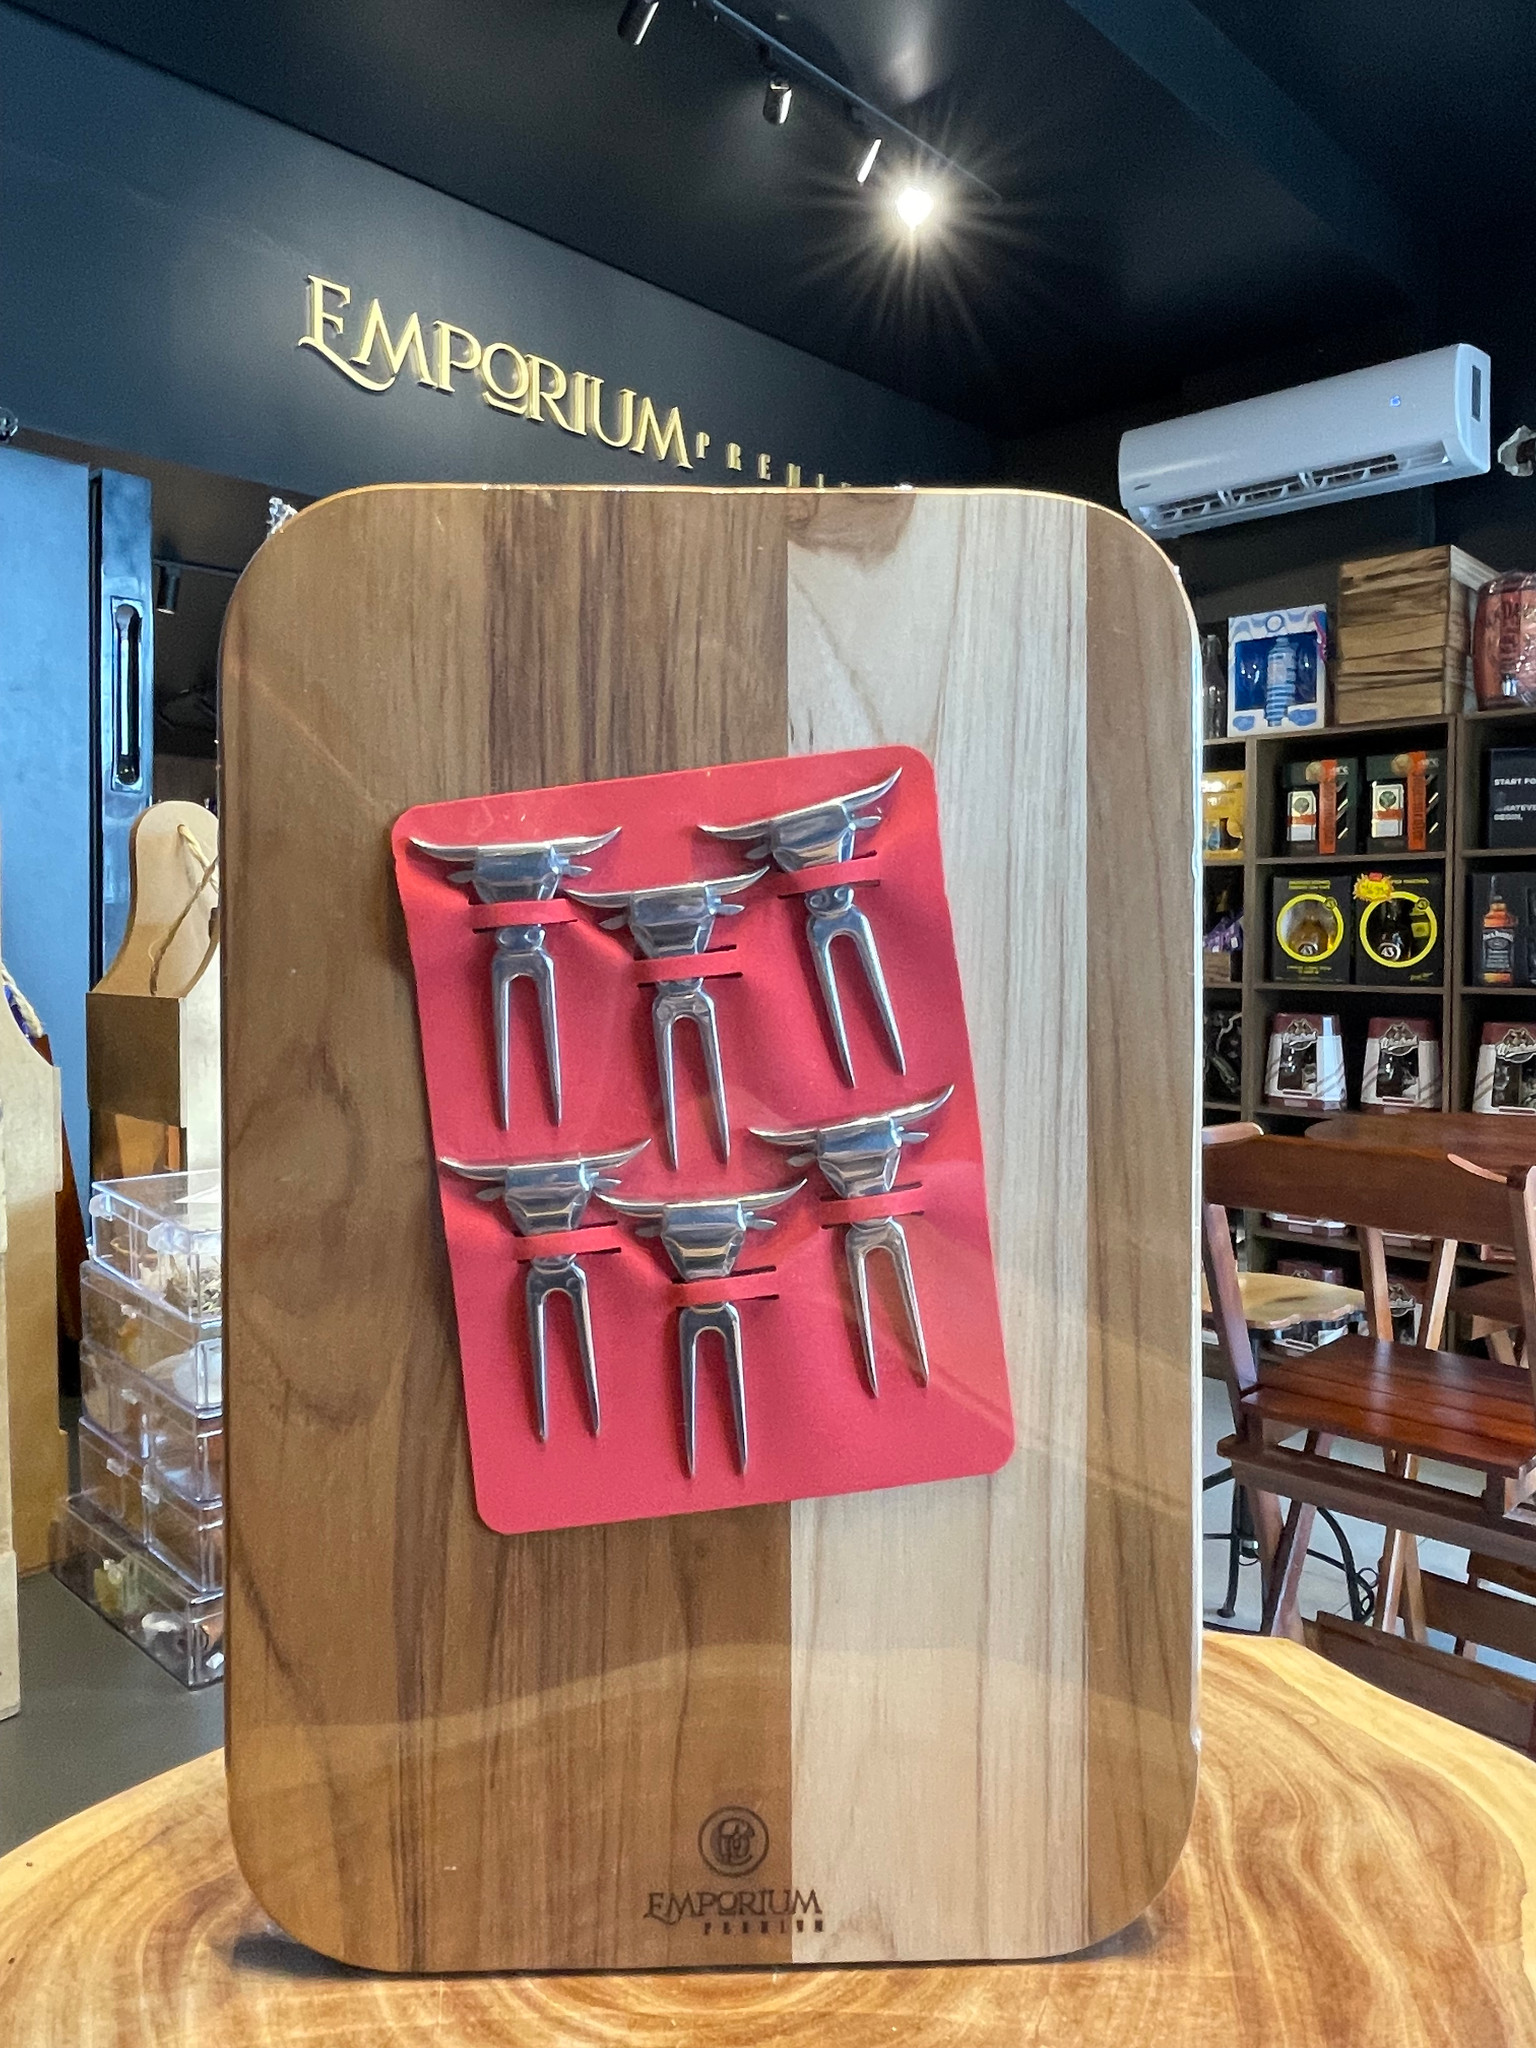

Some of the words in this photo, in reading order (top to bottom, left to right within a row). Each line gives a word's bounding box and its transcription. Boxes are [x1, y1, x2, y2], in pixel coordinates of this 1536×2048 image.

[297, 273, 694, 470] EMPORIUM
[695, 431, 852, 489] PREMI
[643, 1889, 823, 1926] EMPORIUM
